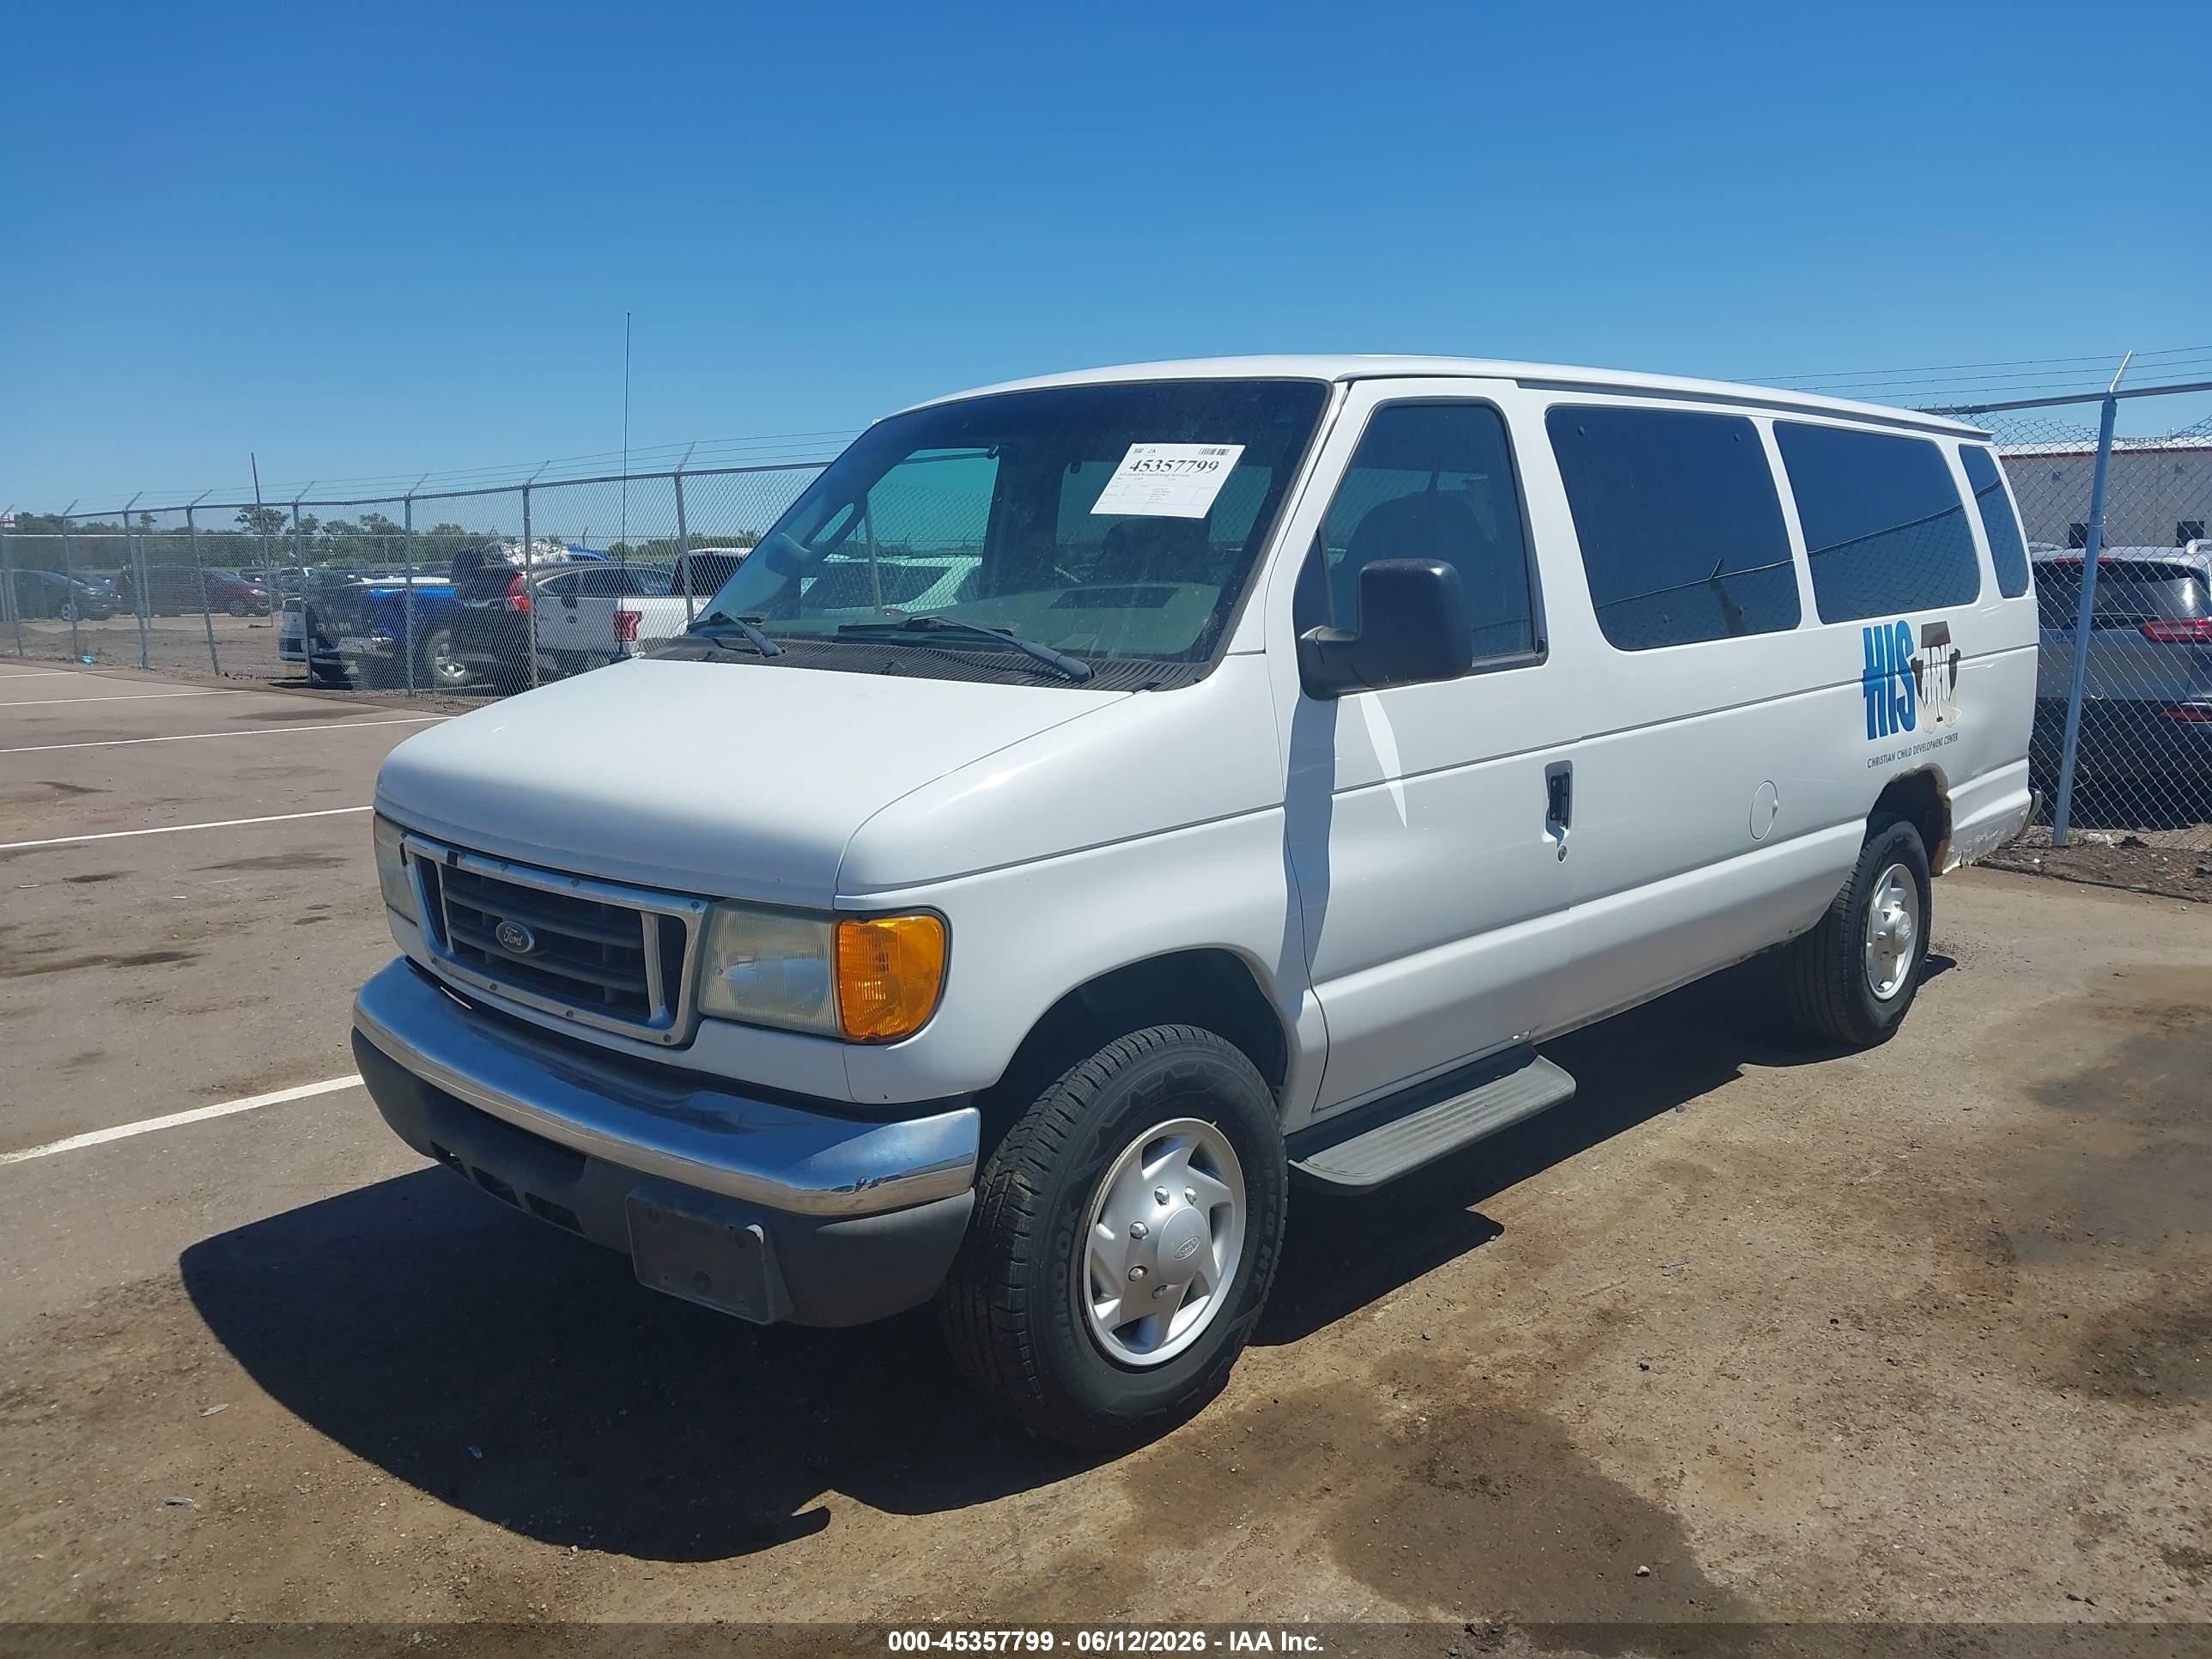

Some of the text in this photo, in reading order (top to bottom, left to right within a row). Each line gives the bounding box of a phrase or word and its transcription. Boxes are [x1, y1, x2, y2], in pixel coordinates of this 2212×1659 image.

[1129, 459, 1219, 473] 45357799
[1863, 620, 1916, 740] HIS
[1867, 732, 1959, 769] CHRISTIAN CHILD DEVELOPMENT CENTER
[503, 927, 522, 946] Ford
